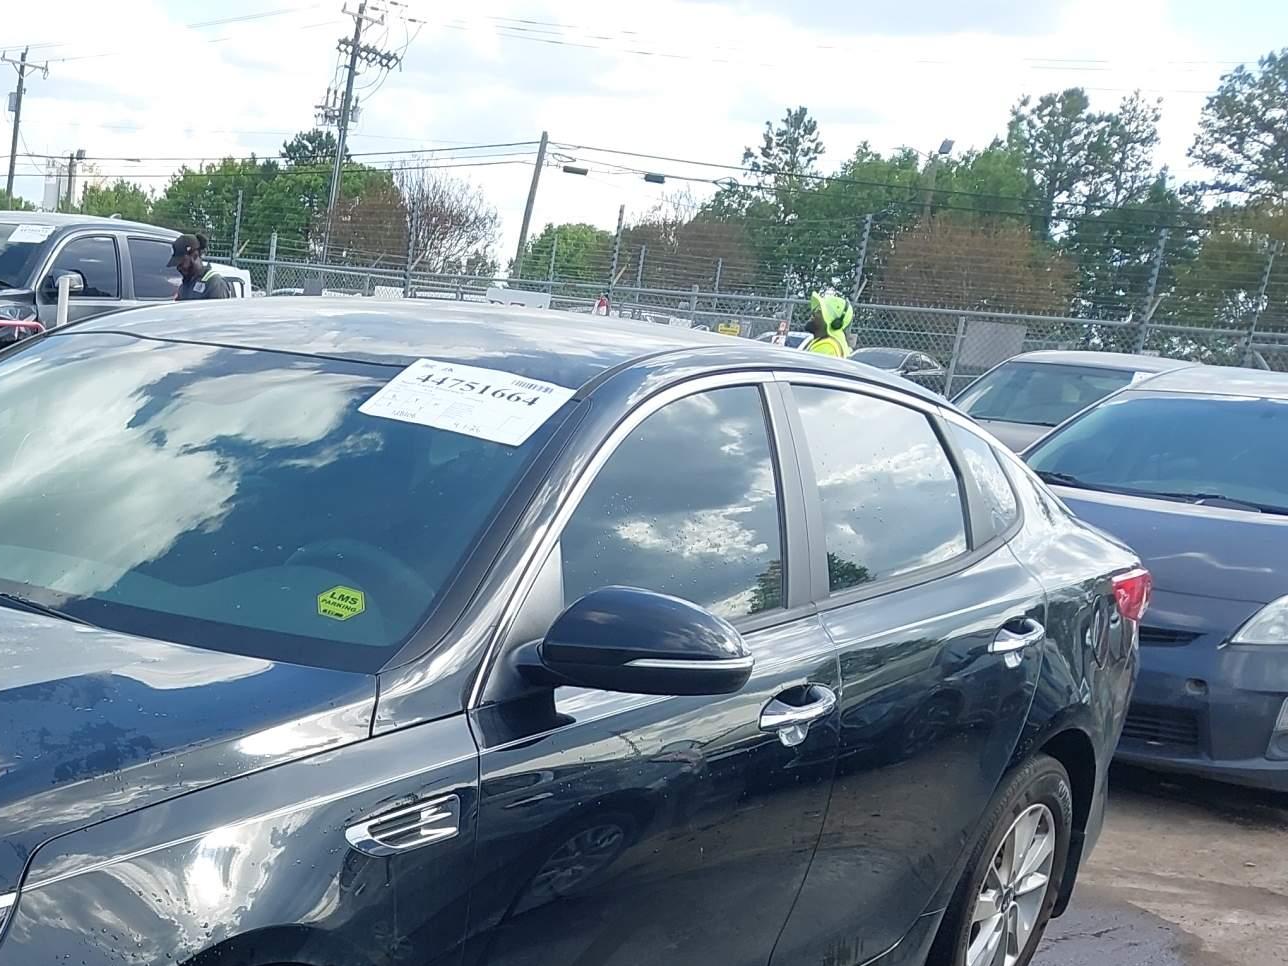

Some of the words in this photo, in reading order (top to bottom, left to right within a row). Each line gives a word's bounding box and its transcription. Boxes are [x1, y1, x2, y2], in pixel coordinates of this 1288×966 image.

[416, 373, 540, 406] 44751664
[321, 598, 357, 612] PARKING
[330, 592, 359, 605] LMS
